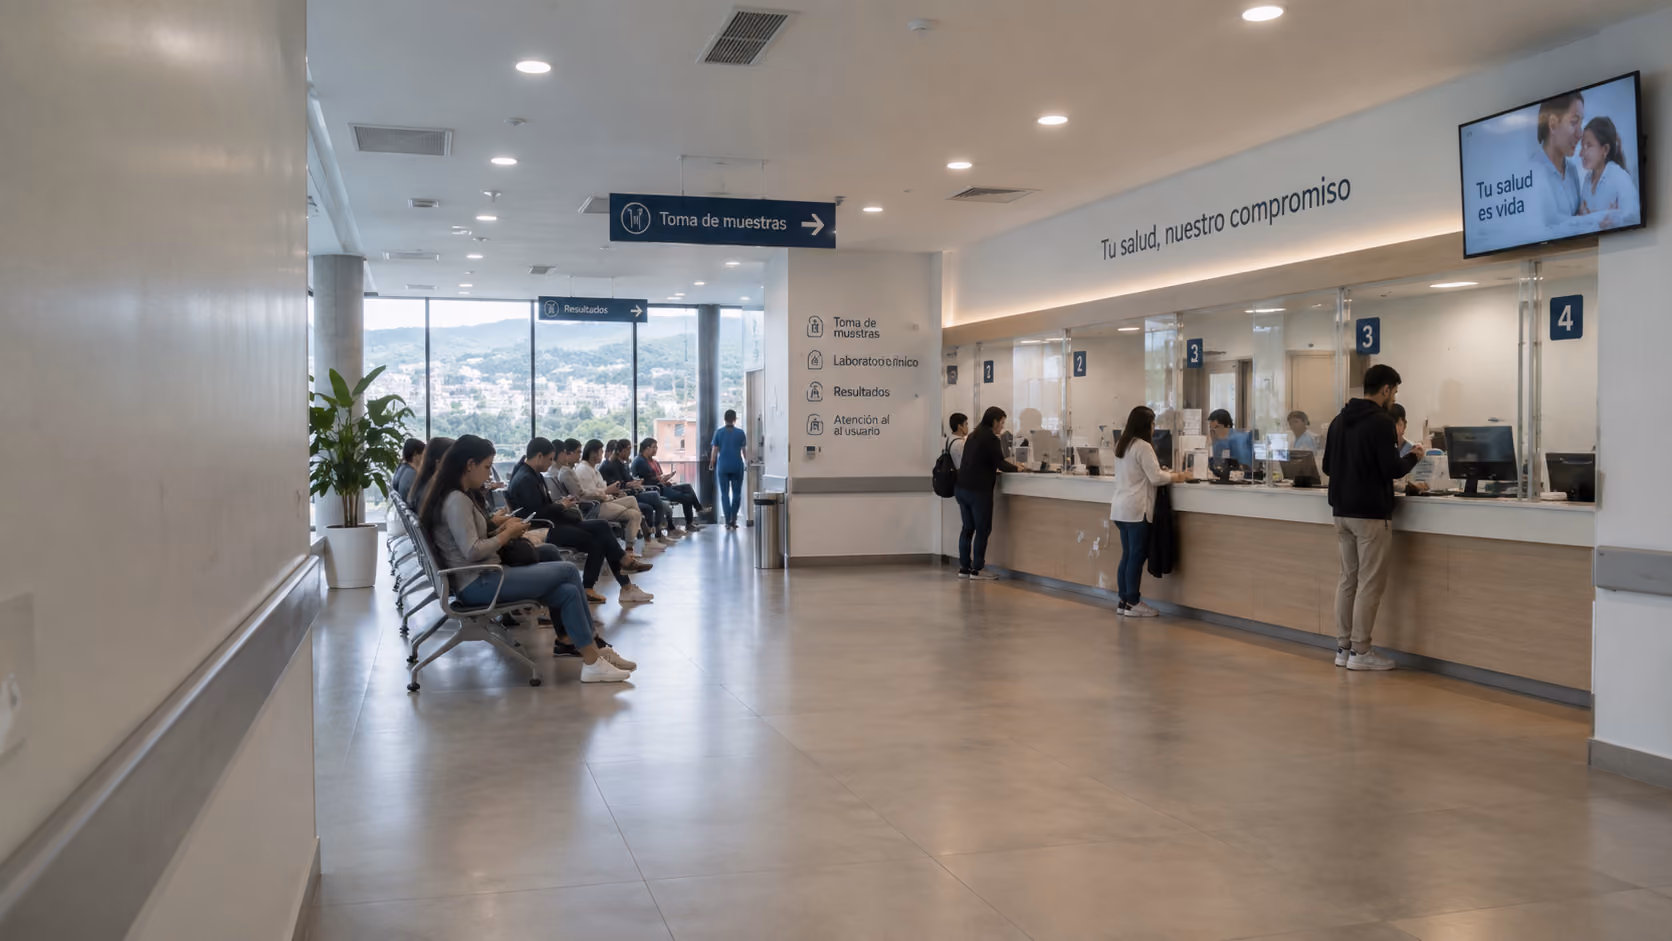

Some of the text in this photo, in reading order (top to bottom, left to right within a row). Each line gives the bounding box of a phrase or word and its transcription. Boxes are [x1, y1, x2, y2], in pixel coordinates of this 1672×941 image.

[1476, 170, 1533, 200] Tu salud
[1101, 176, 1352, 260] Tu salud, nuestro compromiso
[1478, 197, 1525, 221] es vida
[660, 211, 787, 230] Toma de muestras
[833, 316, 877, 328] Toma de
[1557, 304, 1574, 331] 4
[1362, 324, 1374, 349] 3
[1076, 355, 1083, 372] 2
[833, 386, 890, 397] Resultados
[833, 414, 890, 425] Atención al
[833, 427, 843, 436] al
